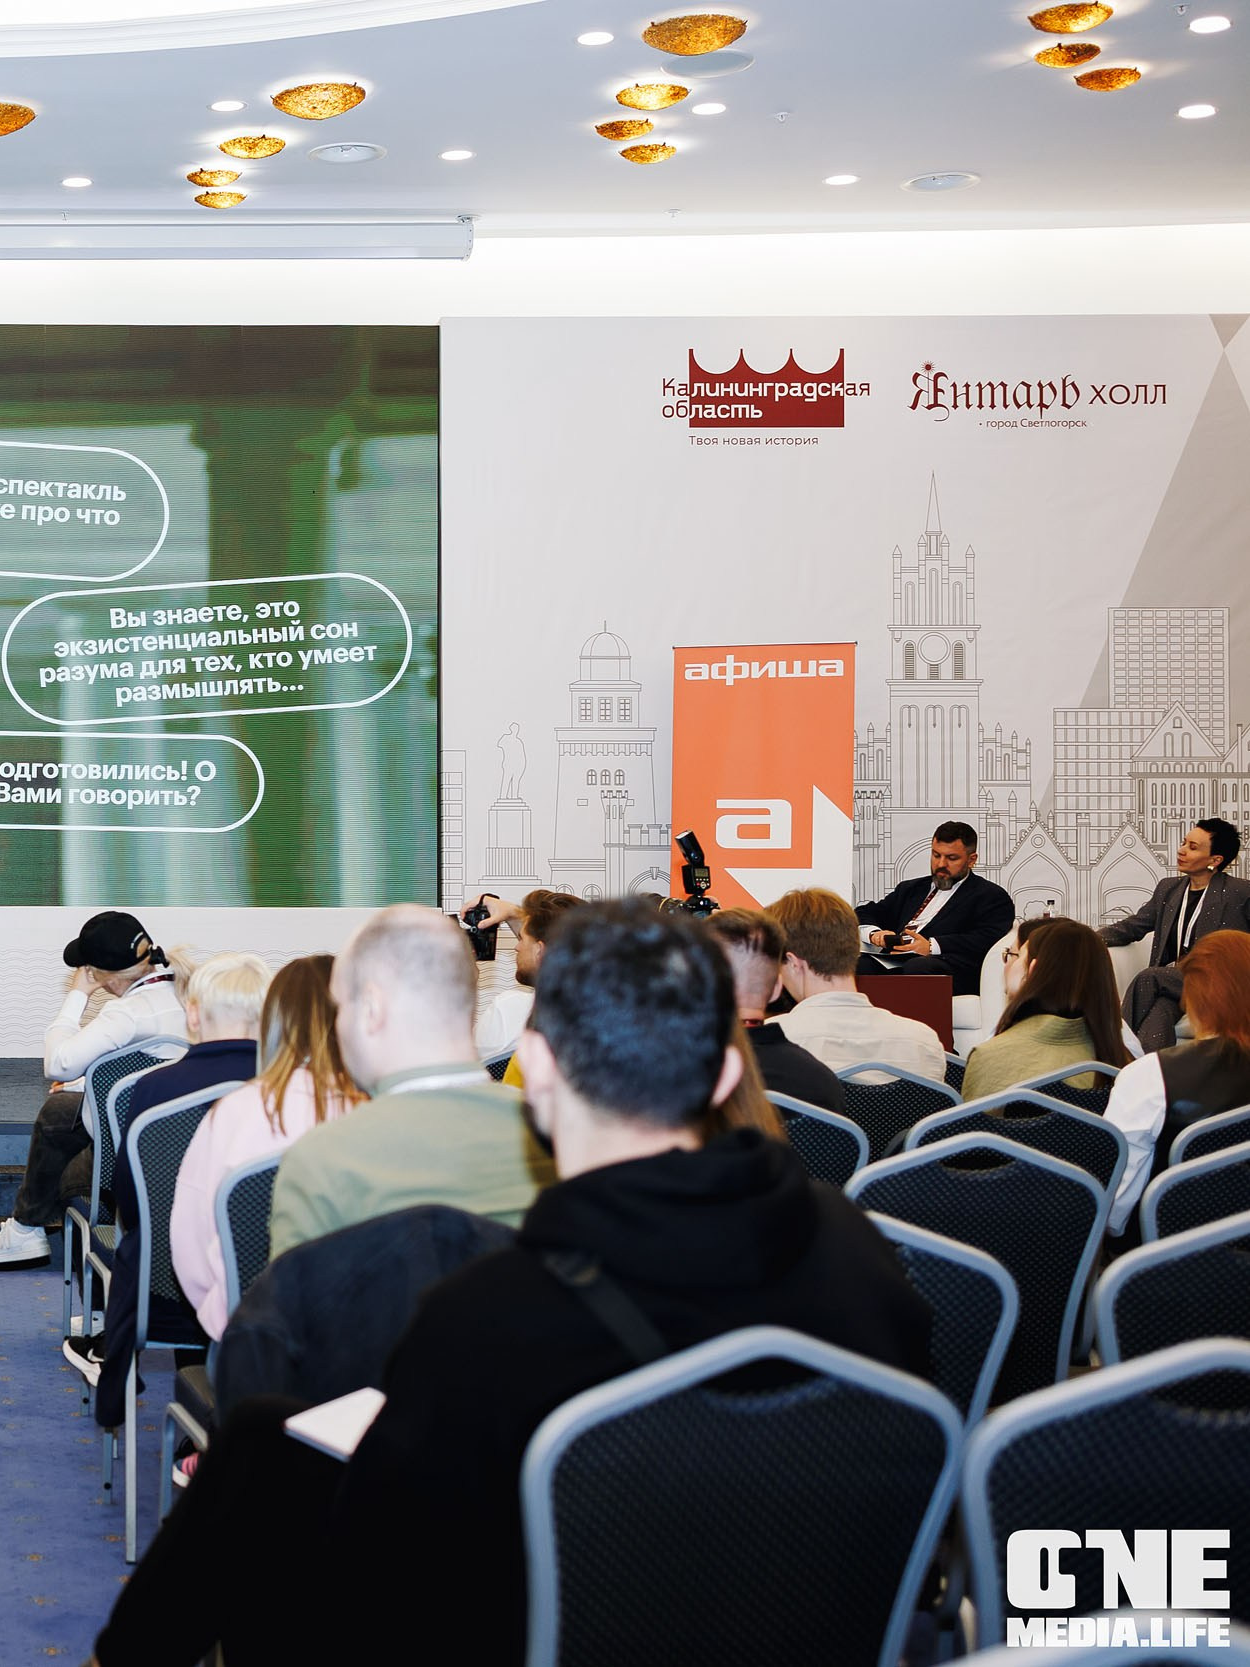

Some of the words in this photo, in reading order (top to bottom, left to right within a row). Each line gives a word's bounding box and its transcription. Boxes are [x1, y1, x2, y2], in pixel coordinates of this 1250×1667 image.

[662, 378, 870, 402] Калининградская
[662, 400, 763, 419] область
[986, 420, 1018, 430] город
[1020, 418, 1087, 429] Светлогорск
[689, 435, 718, 446] Твоя
[722, 437, 761, 446] новая
[765, 437, 819, 448] история
[21, 503, 70, 526] про
[76, 506, 120, 526] что
[110, 608, 146, 629] Вы
[153, 605, 249, 626] знаете,
[255, 600, 300, 619] это
[54, 620, 305, 658] экзистенциальный
[310, 621, 359, 640] сон
[39, 660, 134, 687] разума
[140, 658, 186, 680] для
[192, 654, 242, 673] тех,
[249, 650, 293, 669] кто
[297, 645, 377, 670] умеет
[684, 654, 844, 686] афиша
[115, 675, 304, 706] размышлять...
[195, 760, 217, 782] О
[68, 786, 201, 810] говорить?
[715, 798, 792, 849] а
